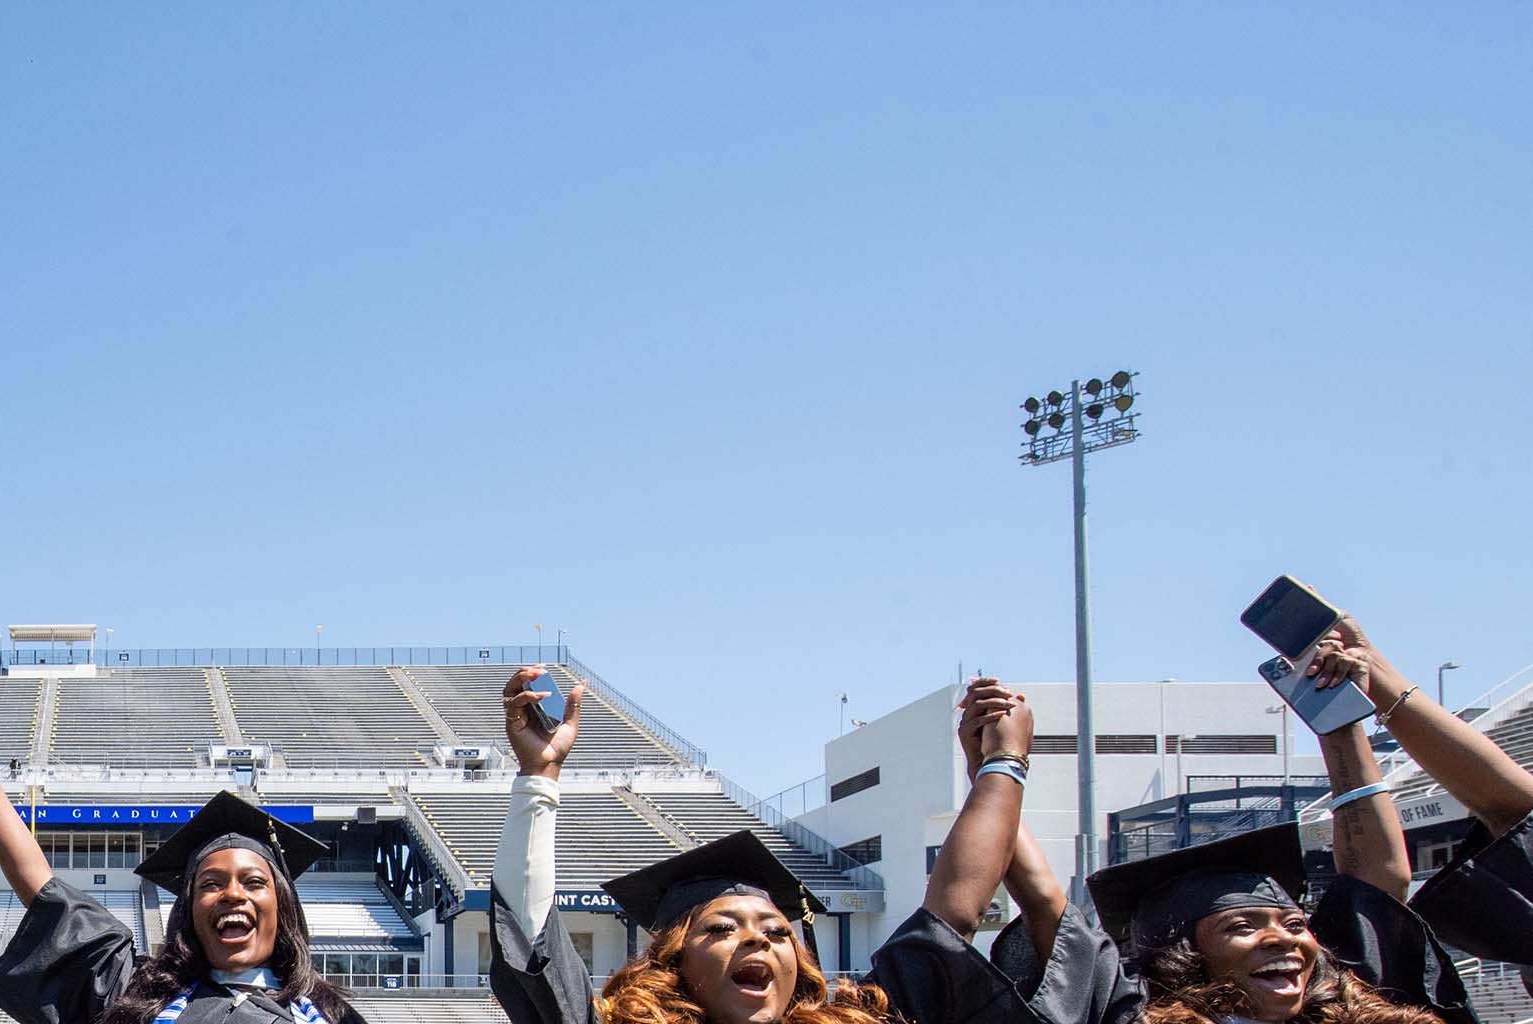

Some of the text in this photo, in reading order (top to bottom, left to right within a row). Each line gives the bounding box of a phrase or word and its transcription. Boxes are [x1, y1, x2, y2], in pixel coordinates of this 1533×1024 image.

[72, 808, 196, 819] GRADUAT
[1401, 802, 1444, 822] OF FAME
[555, 894, 616, 906] INT CAST
